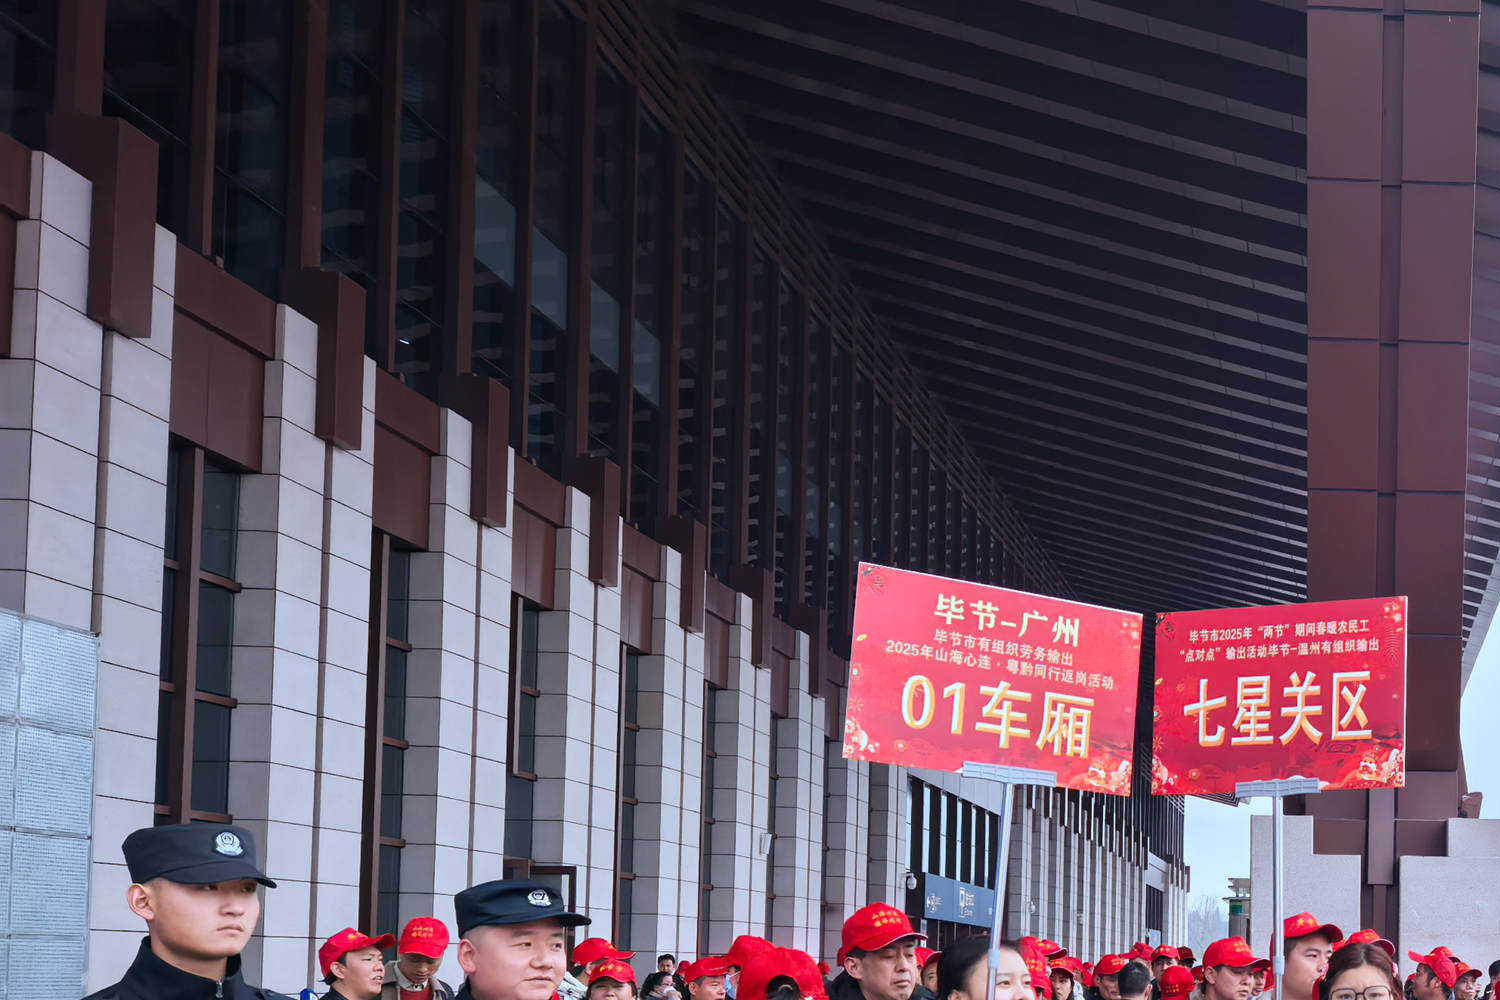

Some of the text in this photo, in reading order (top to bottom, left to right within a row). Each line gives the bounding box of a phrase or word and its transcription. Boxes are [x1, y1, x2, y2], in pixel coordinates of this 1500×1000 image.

[934, 628, 1073, 666] 毕节市有组织劳务输出
[900, 675, 1095, 760] 01车厢
[1183, 670, 1373, 747] 七星关区
